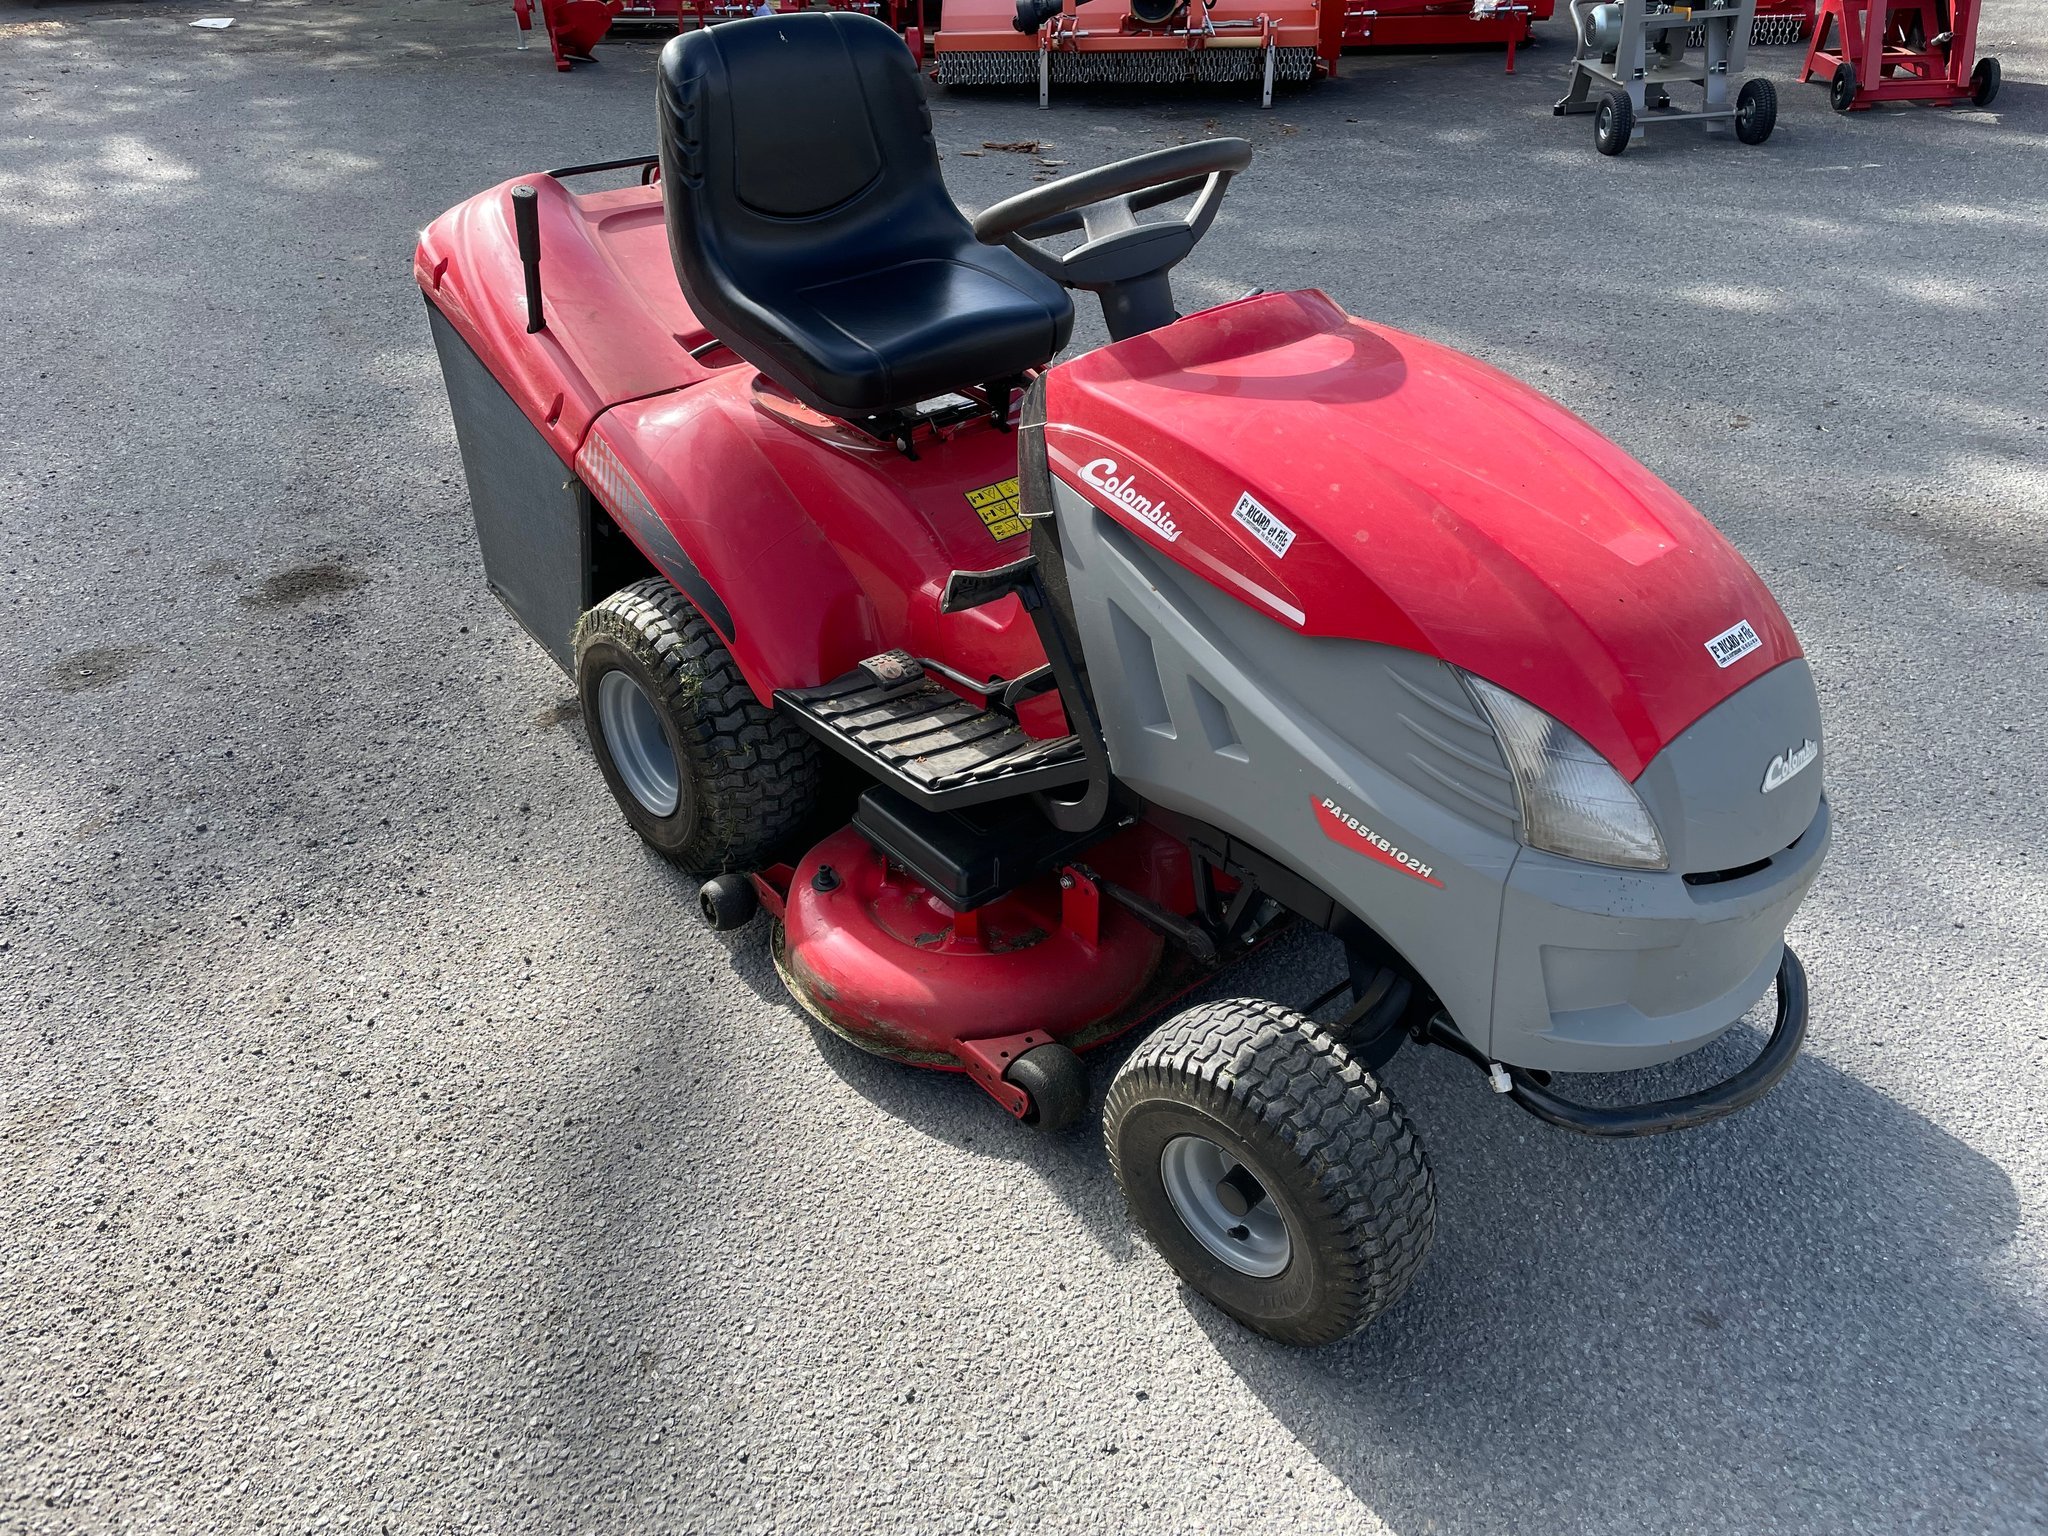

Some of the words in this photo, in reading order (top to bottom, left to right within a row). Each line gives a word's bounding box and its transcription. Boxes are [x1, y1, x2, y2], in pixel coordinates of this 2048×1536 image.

[1078, 458, 1180, 540] Colombia
[1245, 504, 1271, 531] RICARD
[1267, 526, 1278, 538] et
[1274, 529, 1288, 547] Fils
[1717, 633, 1741, 655] RICARD
[1322, 798, 1433, 878] PA185KB102H
